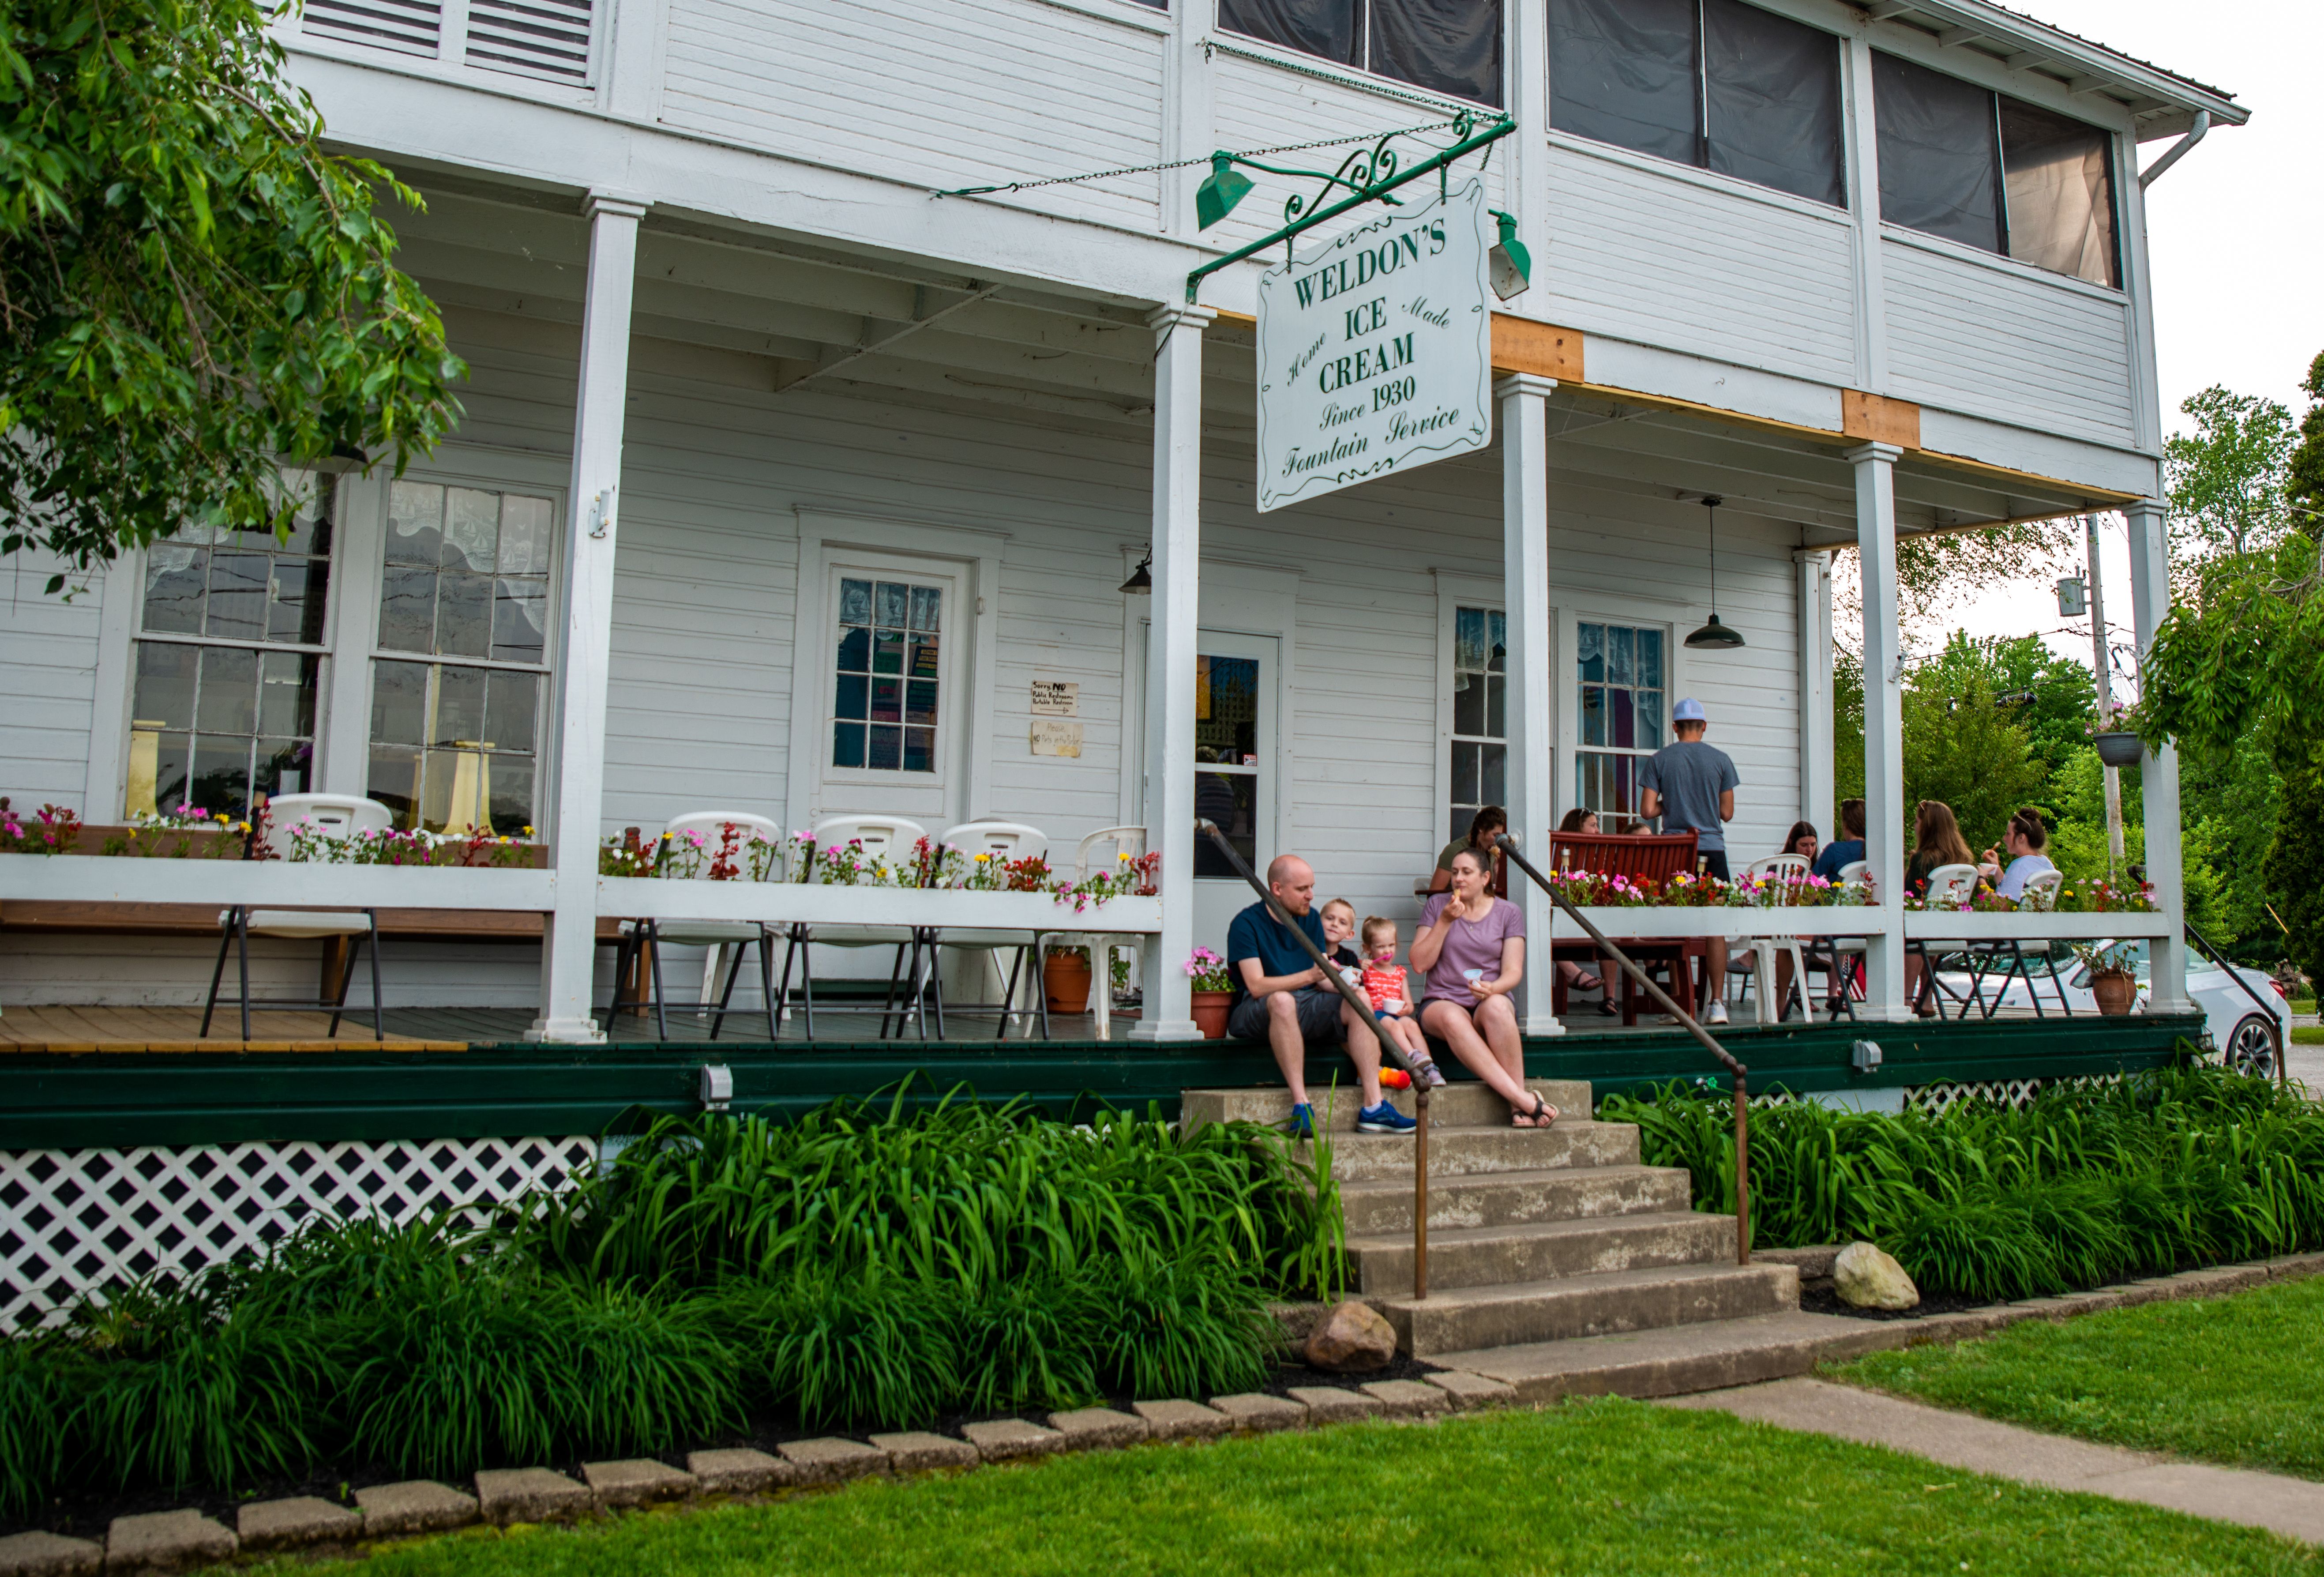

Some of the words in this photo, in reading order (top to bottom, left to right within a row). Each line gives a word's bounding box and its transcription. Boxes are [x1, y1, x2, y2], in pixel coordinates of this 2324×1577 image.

[1294, 218, 1445, 311] WELDON'S
[1287, 332, 1326, 387] Home
[1401, 296, 1450, 329] Made
[1344, 296, 1387, 342] ICE
[1319, 332, 1415, 394] CREAM
[1319, 402, 1365, 431] Since
[1372, 376, 1416, 413] 1930
[1282, 432, 1369, 478] Fountain
[1385, 406, 1459, 444] Service
[1052, 682, 1066, 691] NO
[1042, 734, 1052, 743] Pets
